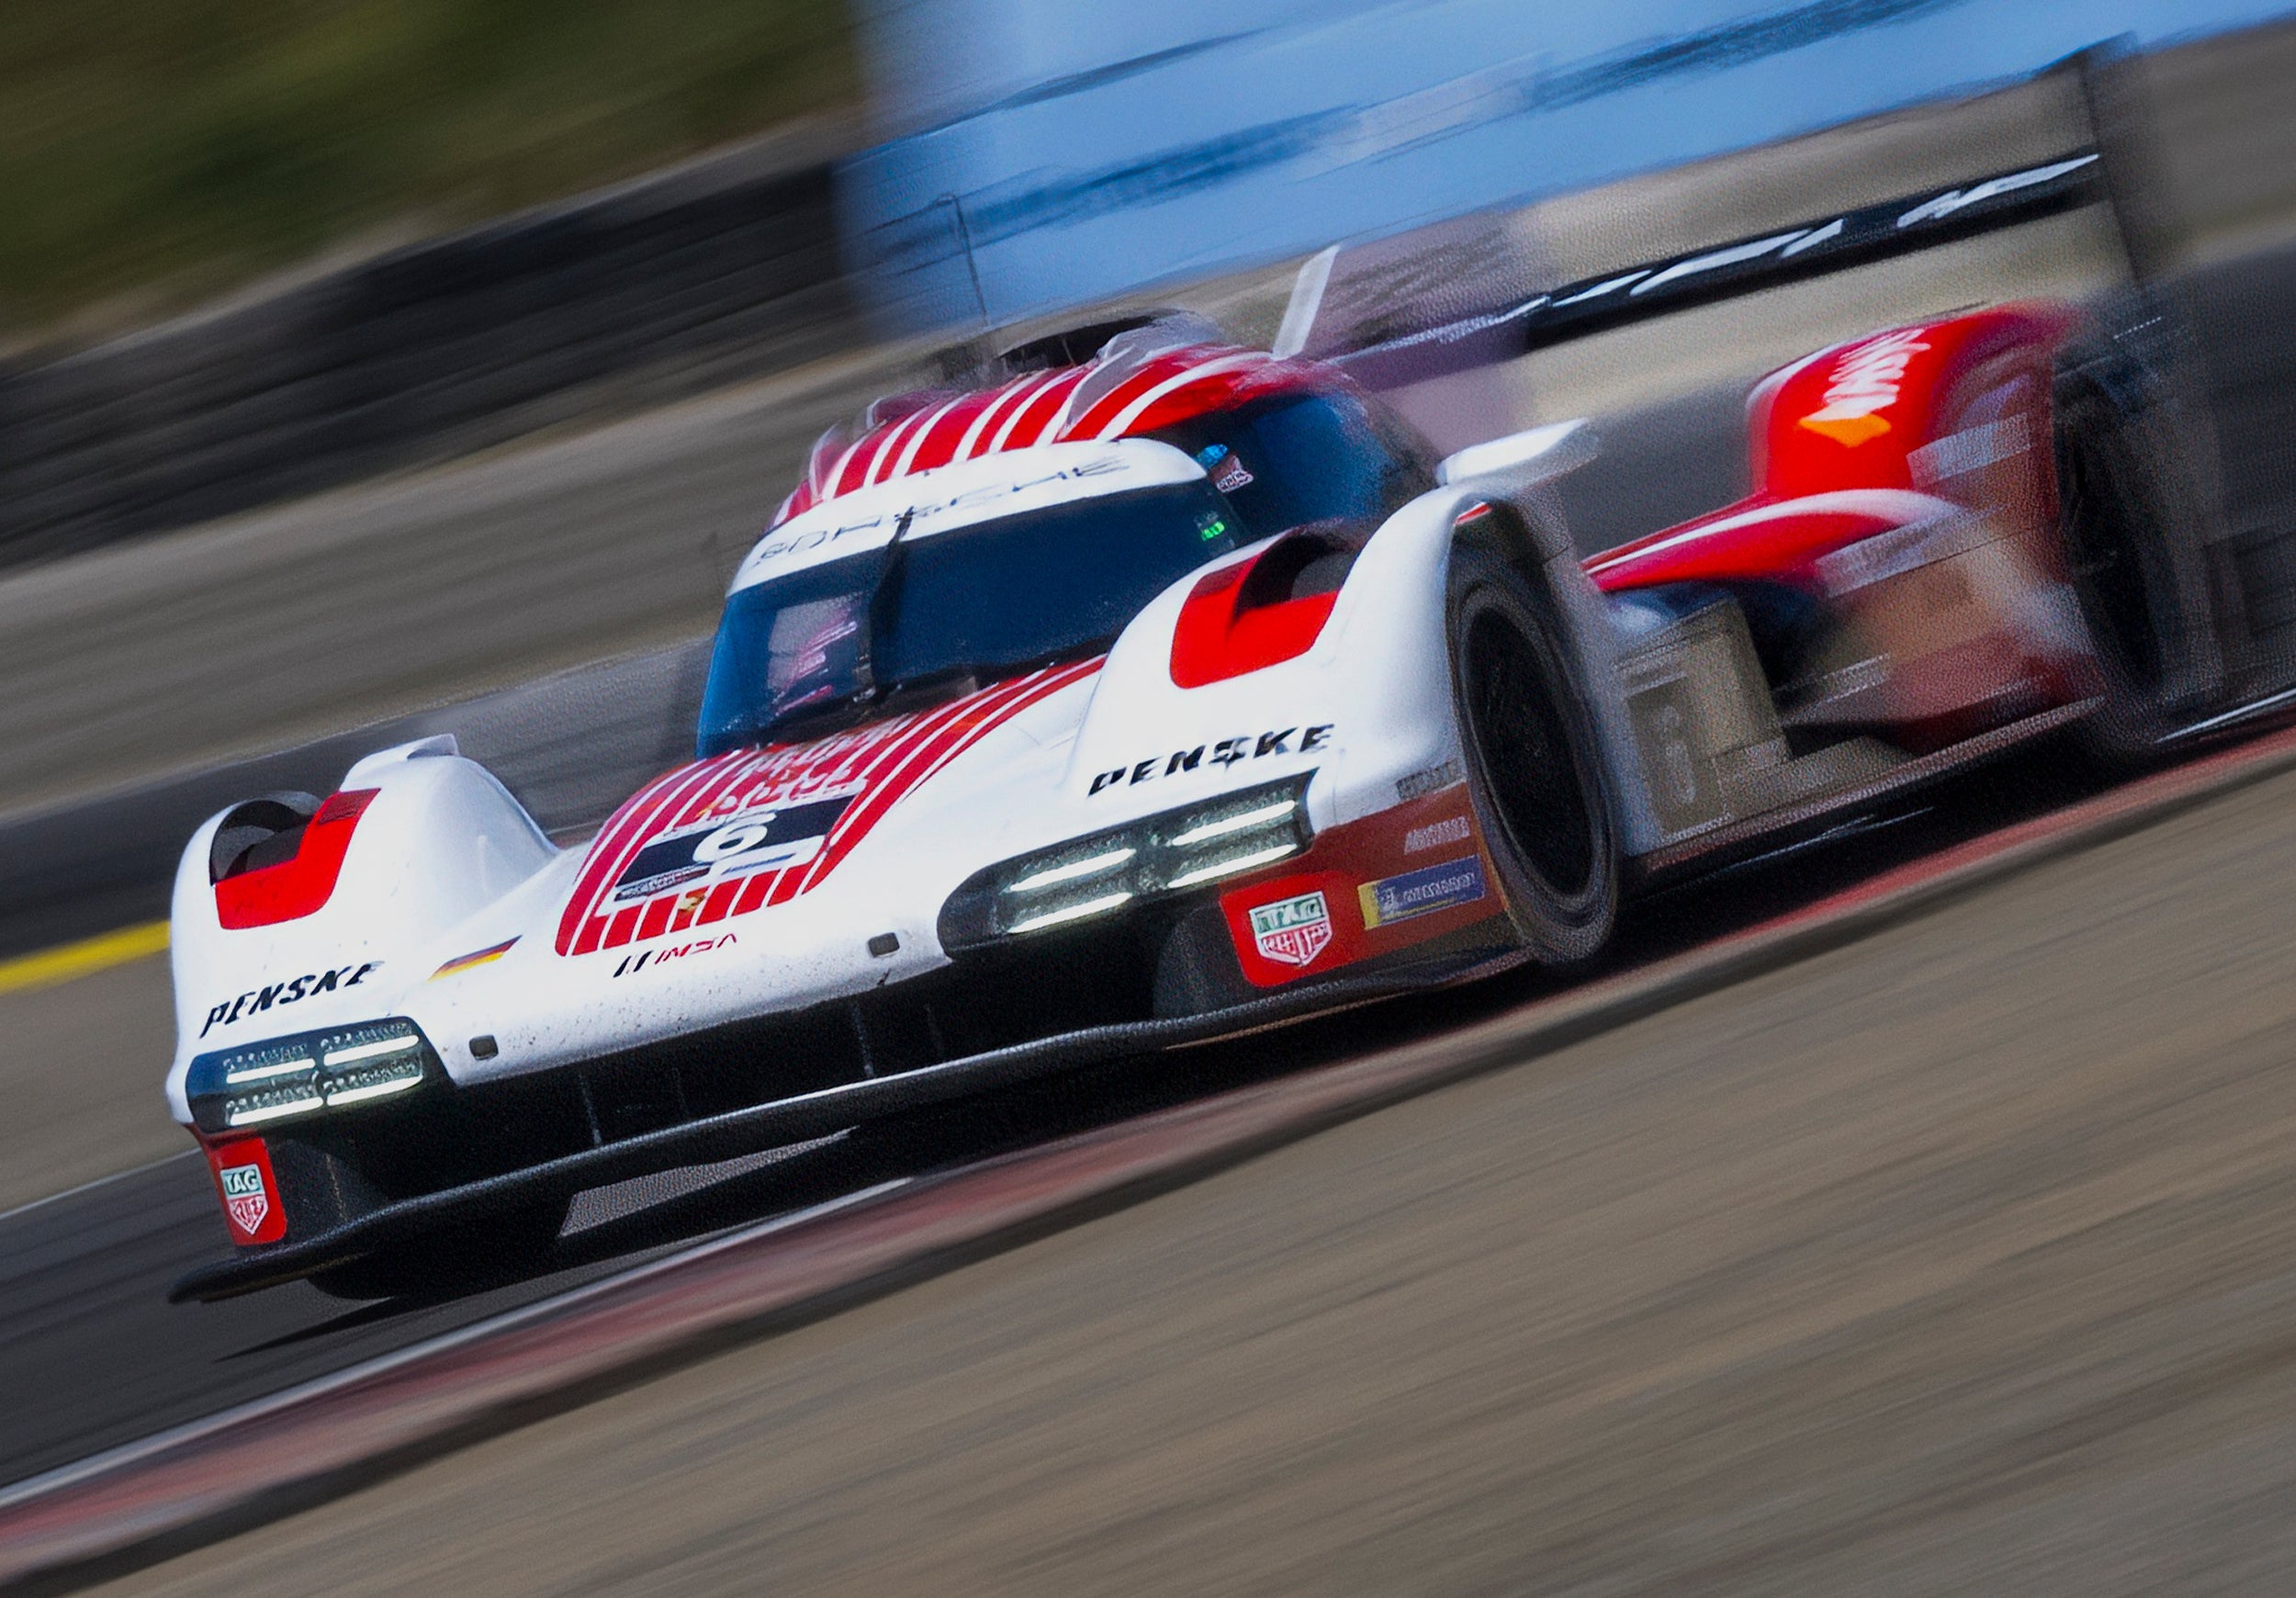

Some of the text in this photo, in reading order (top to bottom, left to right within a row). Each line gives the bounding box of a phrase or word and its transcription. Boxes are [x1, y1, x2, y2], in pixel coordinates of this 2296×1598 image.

[1086, 723, 1334, 797] PENSKE
[692, 811, 778, 863] 6
[199, 961, 386, 1040] PENSKE
[226, 1168, 261, 1194] TAG
